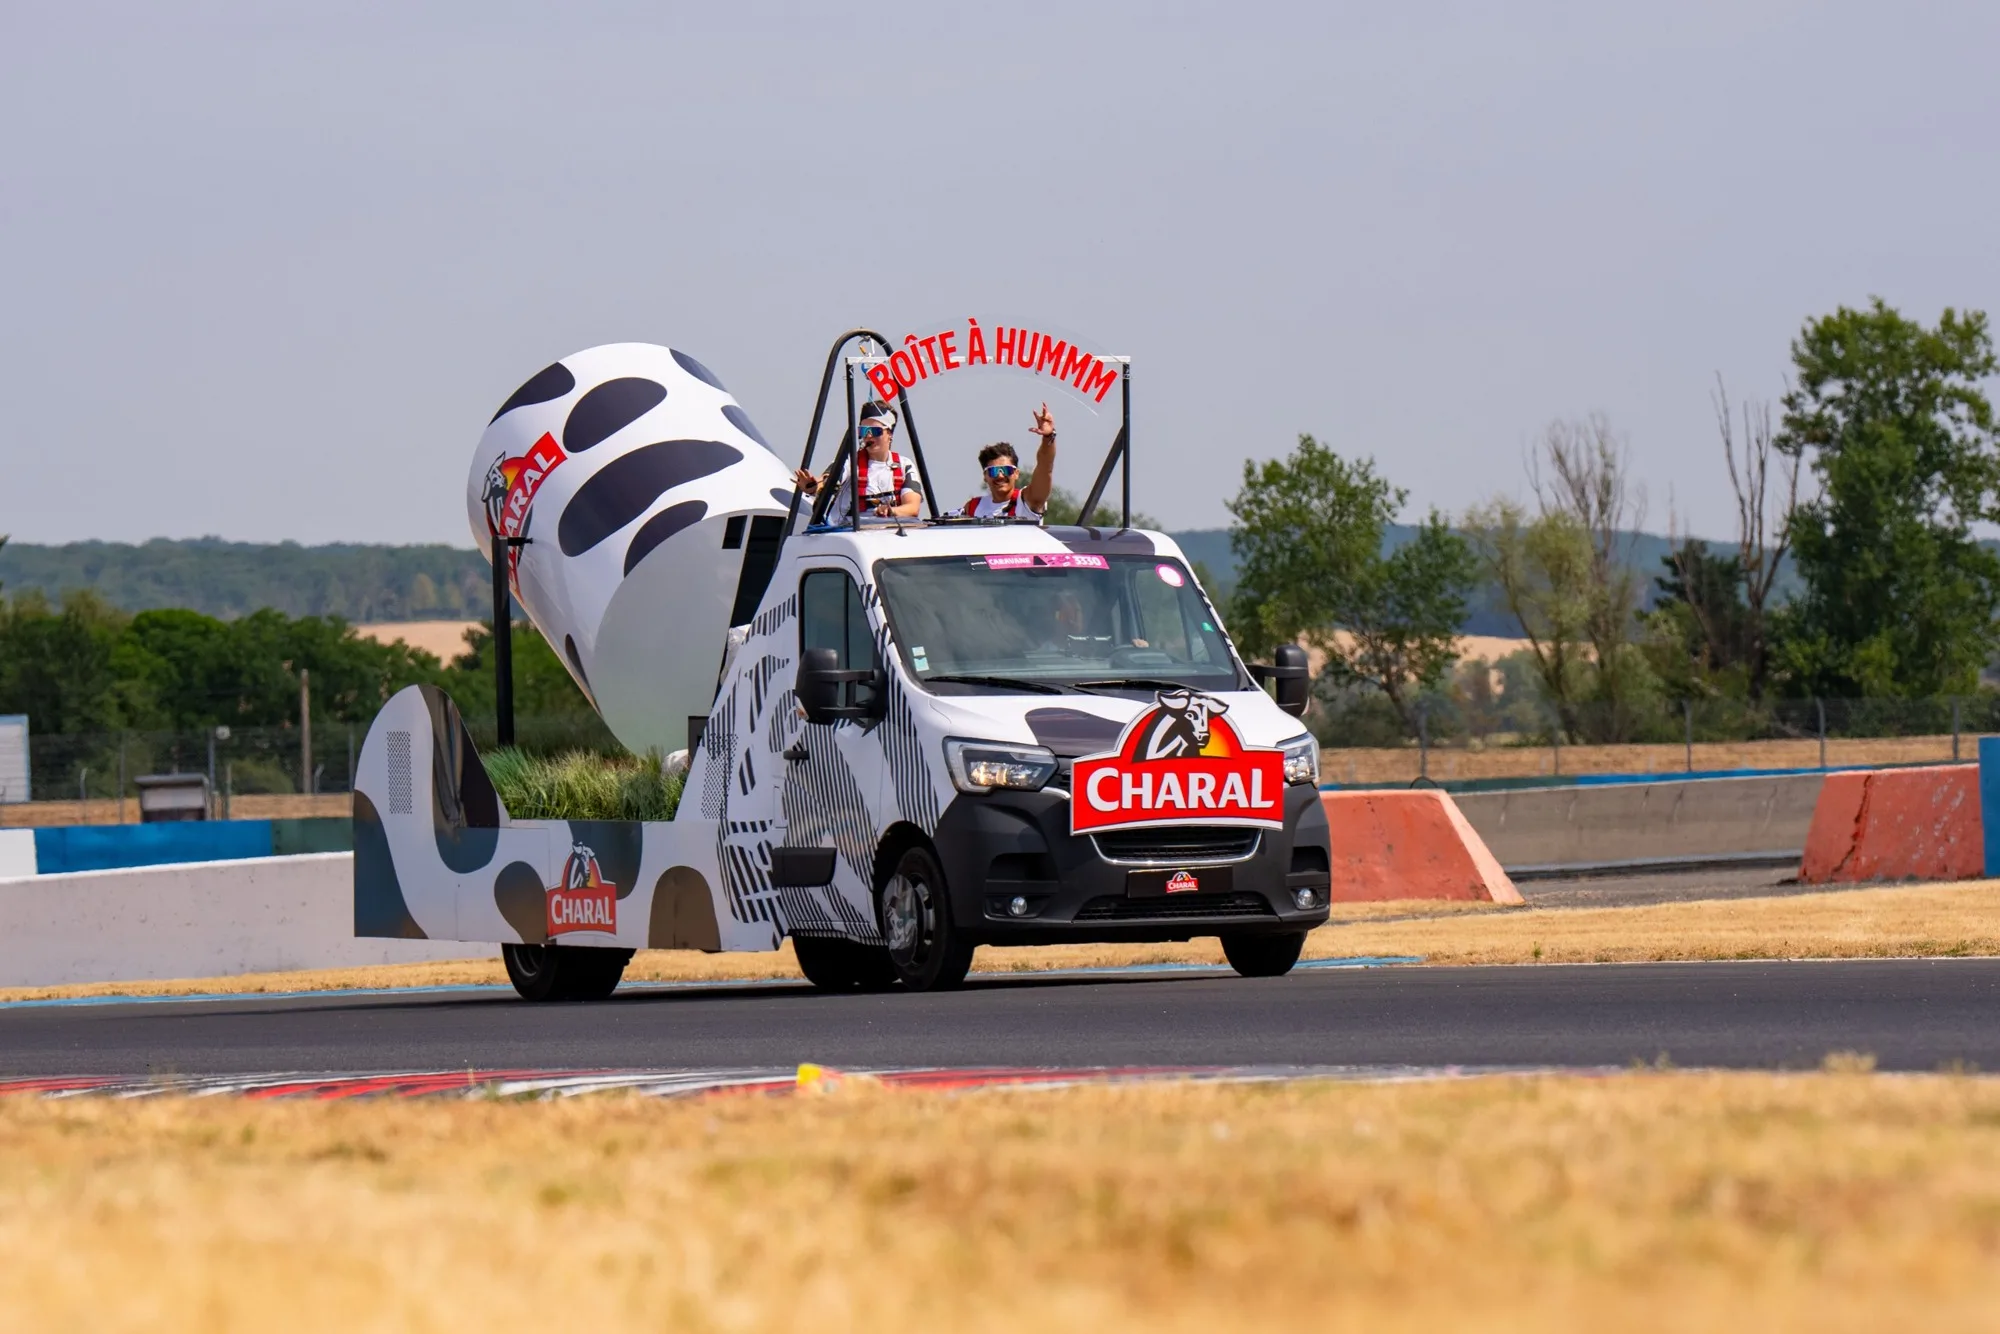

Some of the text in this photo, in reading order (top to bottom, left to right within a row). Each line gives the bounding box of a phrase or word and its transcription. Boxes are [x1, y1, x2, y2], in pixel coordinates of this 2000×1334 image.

[866, 317, 1118, 403] BOÎTE À HUMMM
[988, 557, 1031, 565] CARAVANE
[1086, 767, 1274, 812] CHARAL
[1167, 881, 1197, 890] CHARAL
[551, 893, 613, 925] CHARAL
